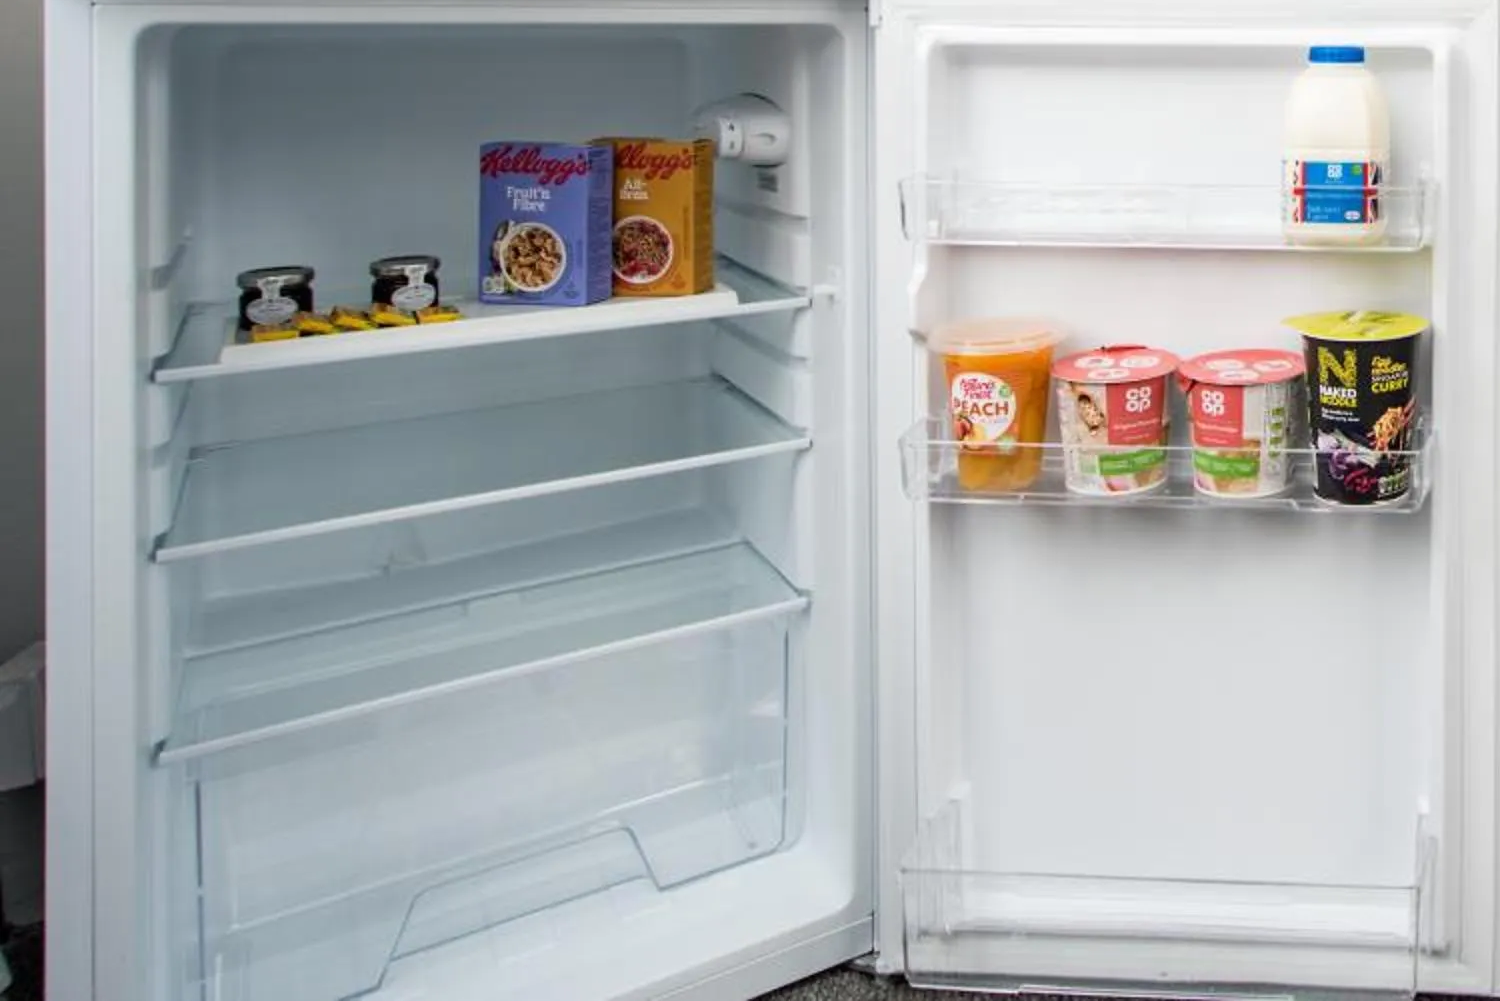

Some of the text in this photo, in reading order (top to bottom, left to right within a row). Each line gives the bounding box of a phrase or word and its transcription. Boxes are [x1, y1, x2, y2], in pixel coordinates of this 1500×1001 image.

[480, 145, 590, 185] Kellogg's
[616, 142, 691, 180] llogg's
[1319, 384, 1357, 398] NAKED
[953, 396, 1010, 417] PEACH
